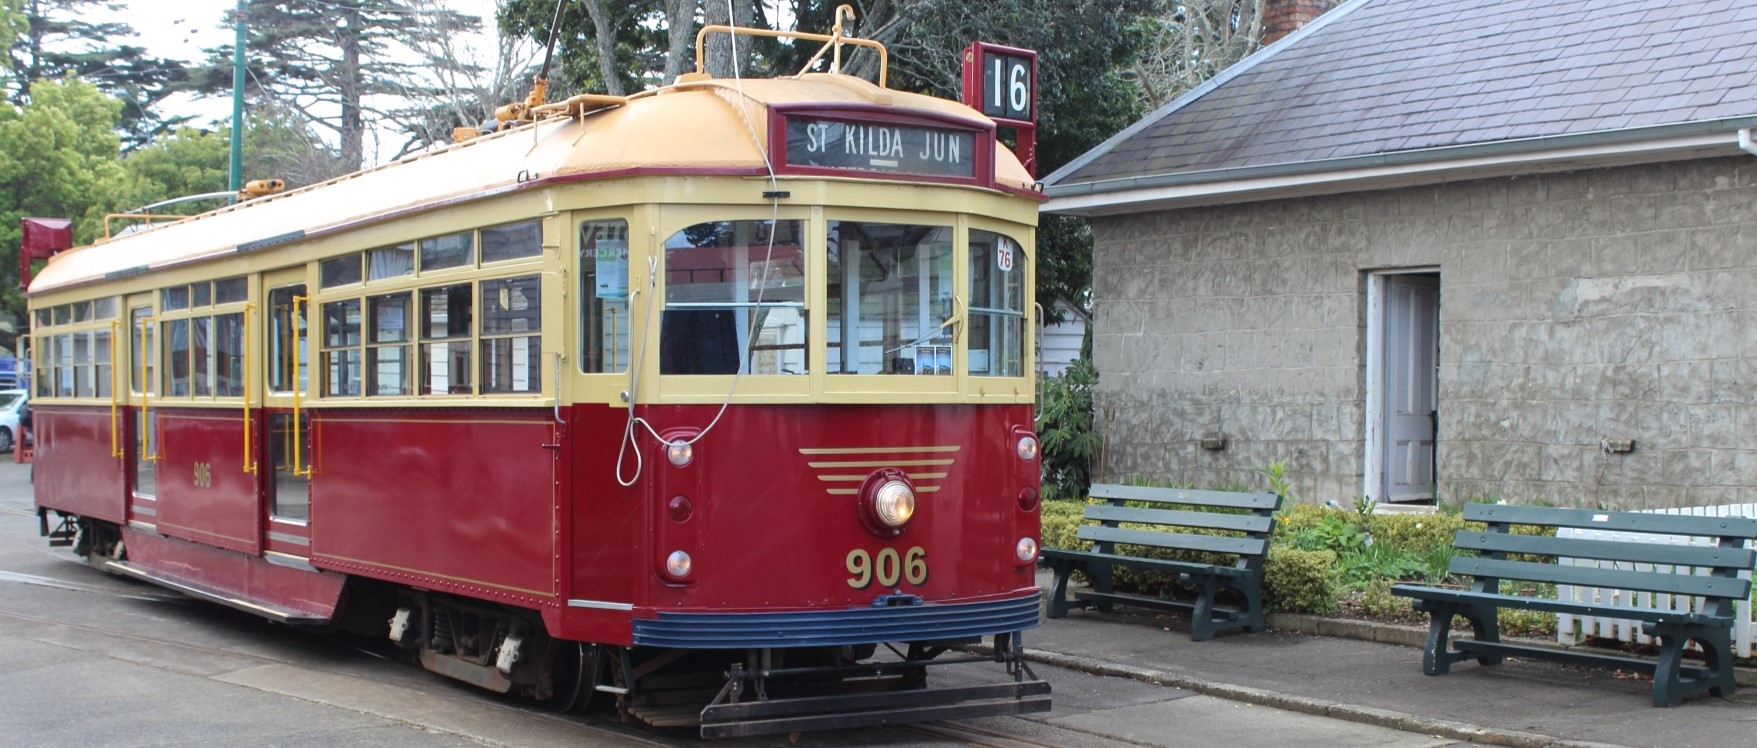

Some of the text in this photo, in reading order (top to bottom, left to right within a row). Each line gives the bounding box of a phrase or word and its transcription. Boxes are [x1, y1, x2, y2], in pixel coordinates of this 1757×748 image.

[994, 58, 1027, 112] 16
[806, 123, 960, 164] ST KILDA JUN
[999, 249, 1011, 269] 76
[193, 461, 212, 489] 906
[845, 546, 928, 590] 906
